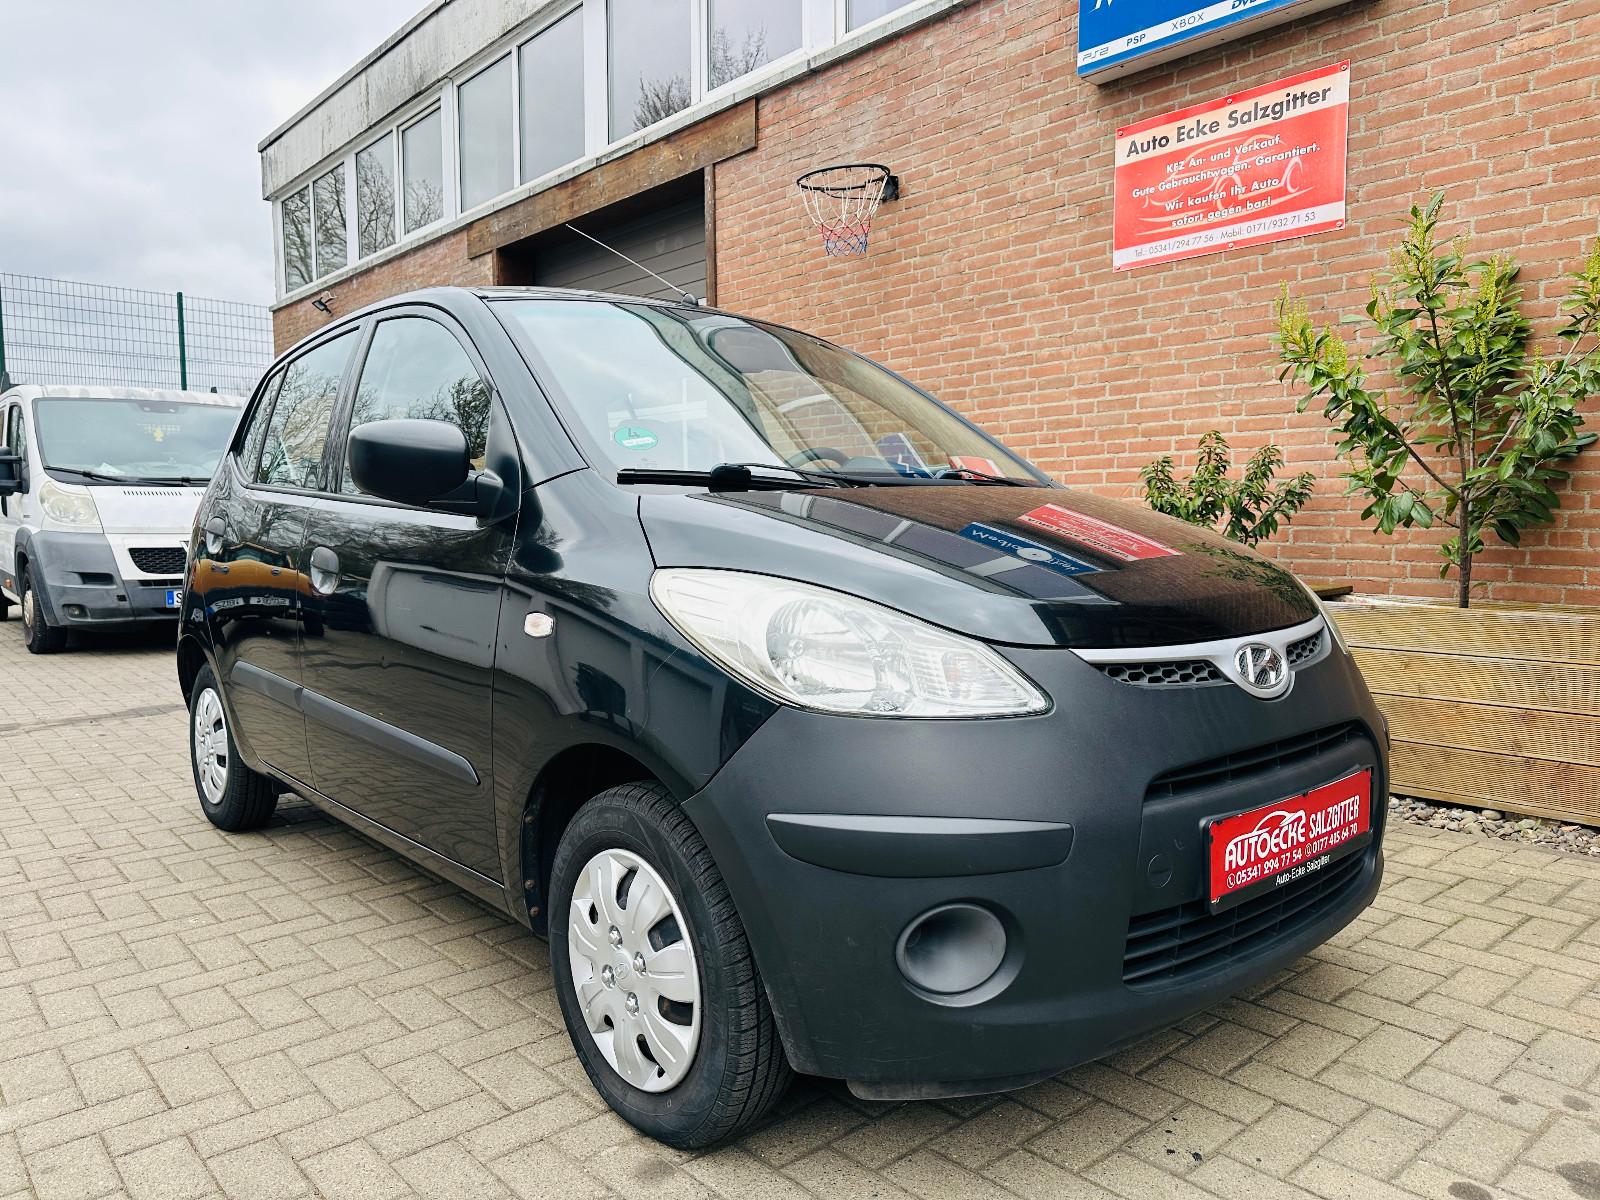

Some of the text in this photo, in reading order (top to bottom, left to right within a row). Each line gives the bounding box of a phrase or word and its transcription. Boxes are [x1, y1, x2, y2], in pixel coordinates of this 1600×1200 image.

[1082, 0, 1258, 61] PS2 PSP XBOX DV
[1126, 86, 1331, 158] Auto Ecke Salzgitter
[1132, 142, 1321, 198] Gute Gebrauchtwagen. Garantiert.
[1166, 134, 1280, 174] KFZ An- und Verkauf
[1165, 177, 1280, 212] Wir kaufen Ihr Auto
[1171, 196, 1271, 228] sofort gegen bar!
[1149, 239, 1191, 255] 05341/294
[1191, 235, 1202, 246] 77
[1204, 233, 1214, 243] 56
[1246, 218, 1289, 234] 0171/932
[1290, 215, 1300, 225] 71
[1304, 211, 1316, 222] 53
[1225, 794, 1360, 872] AUTOECKE SALZGITTER
[1236, 822, 1358, 885] 05341 294 77 54 0177 415 64 70
[1275, 854, 1331, 887] Auto-Ecke Salzgitter
